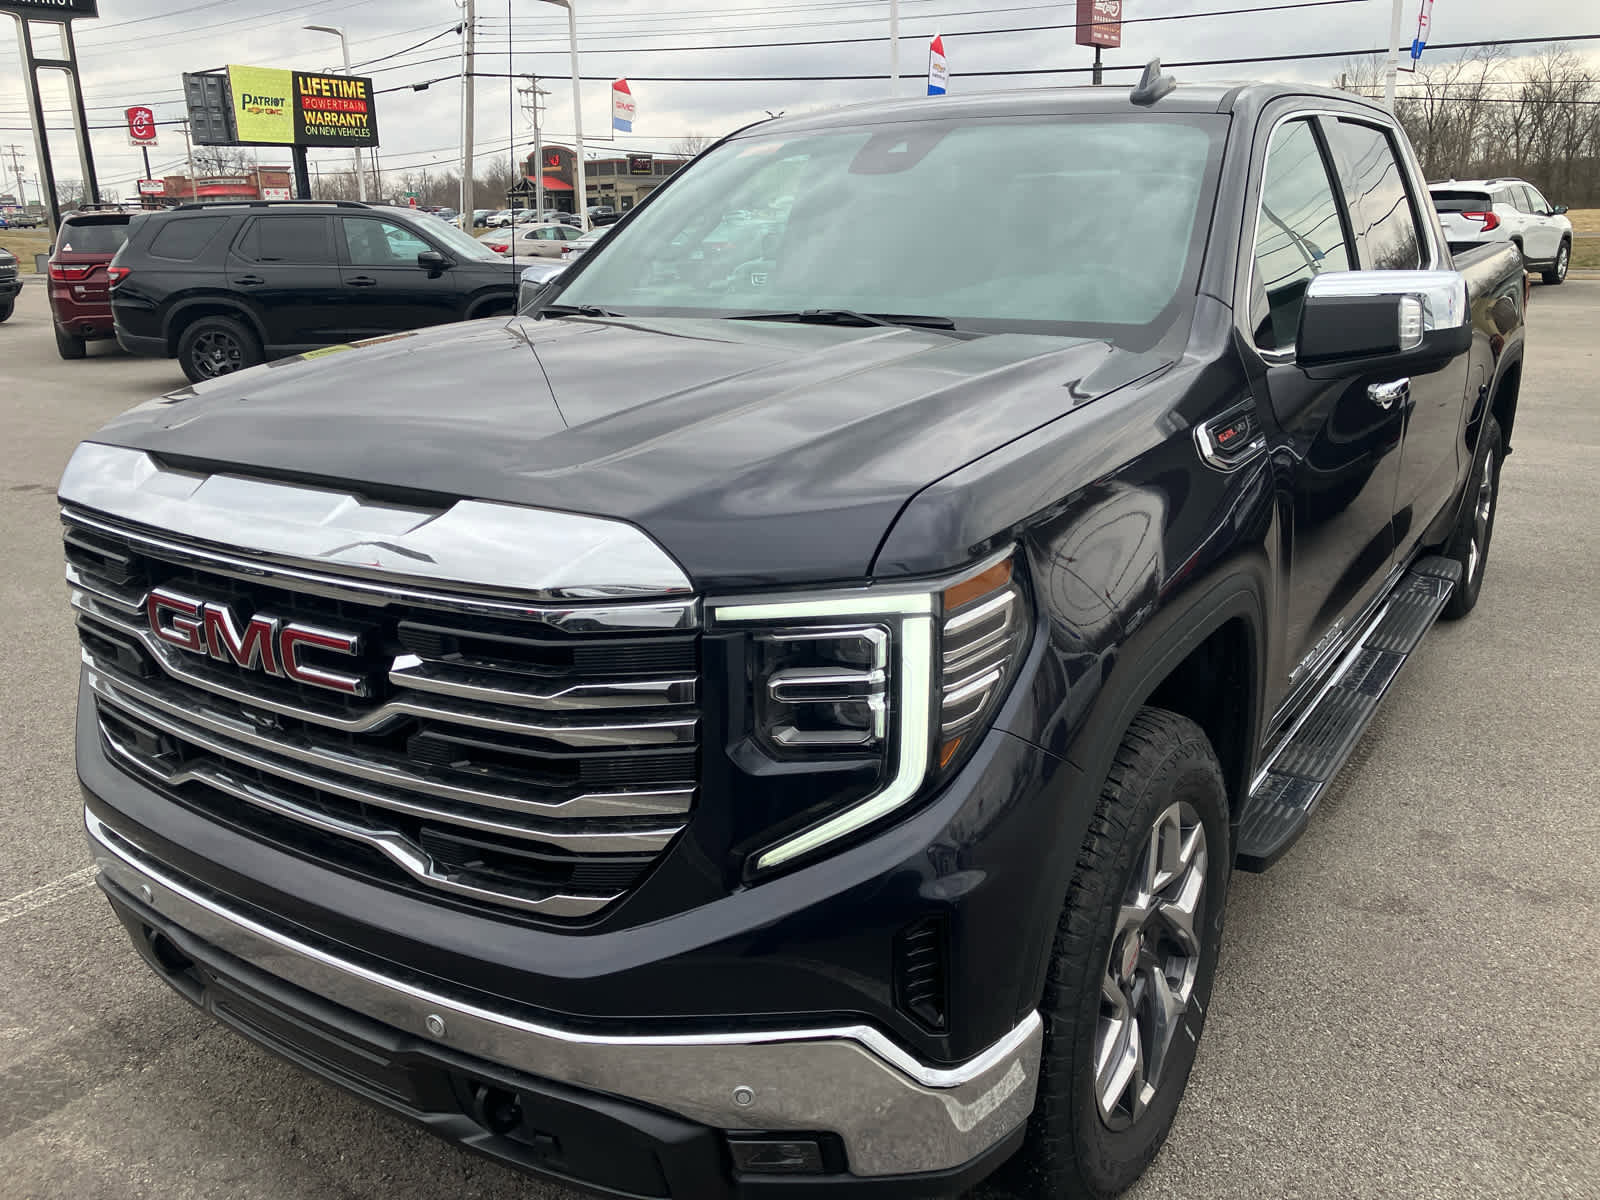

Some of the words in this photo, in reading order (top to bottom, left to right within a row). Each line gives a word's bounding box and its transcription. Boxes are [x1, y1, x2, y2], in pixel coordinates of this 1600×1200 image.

[298, 76, 366, 98] LIFETIME
[242, 93, 285, 110] PATRIOT
[305, 97, 364, 111] POWERTRAIN
[303, 110, 368, 127] WARRANTY
[305, 125, 318, 135] ON
[319, 126, 337, 136] NEW
[337, 127, 371, 137] VEHICLES
[147, 587, 367, 697] GMC
